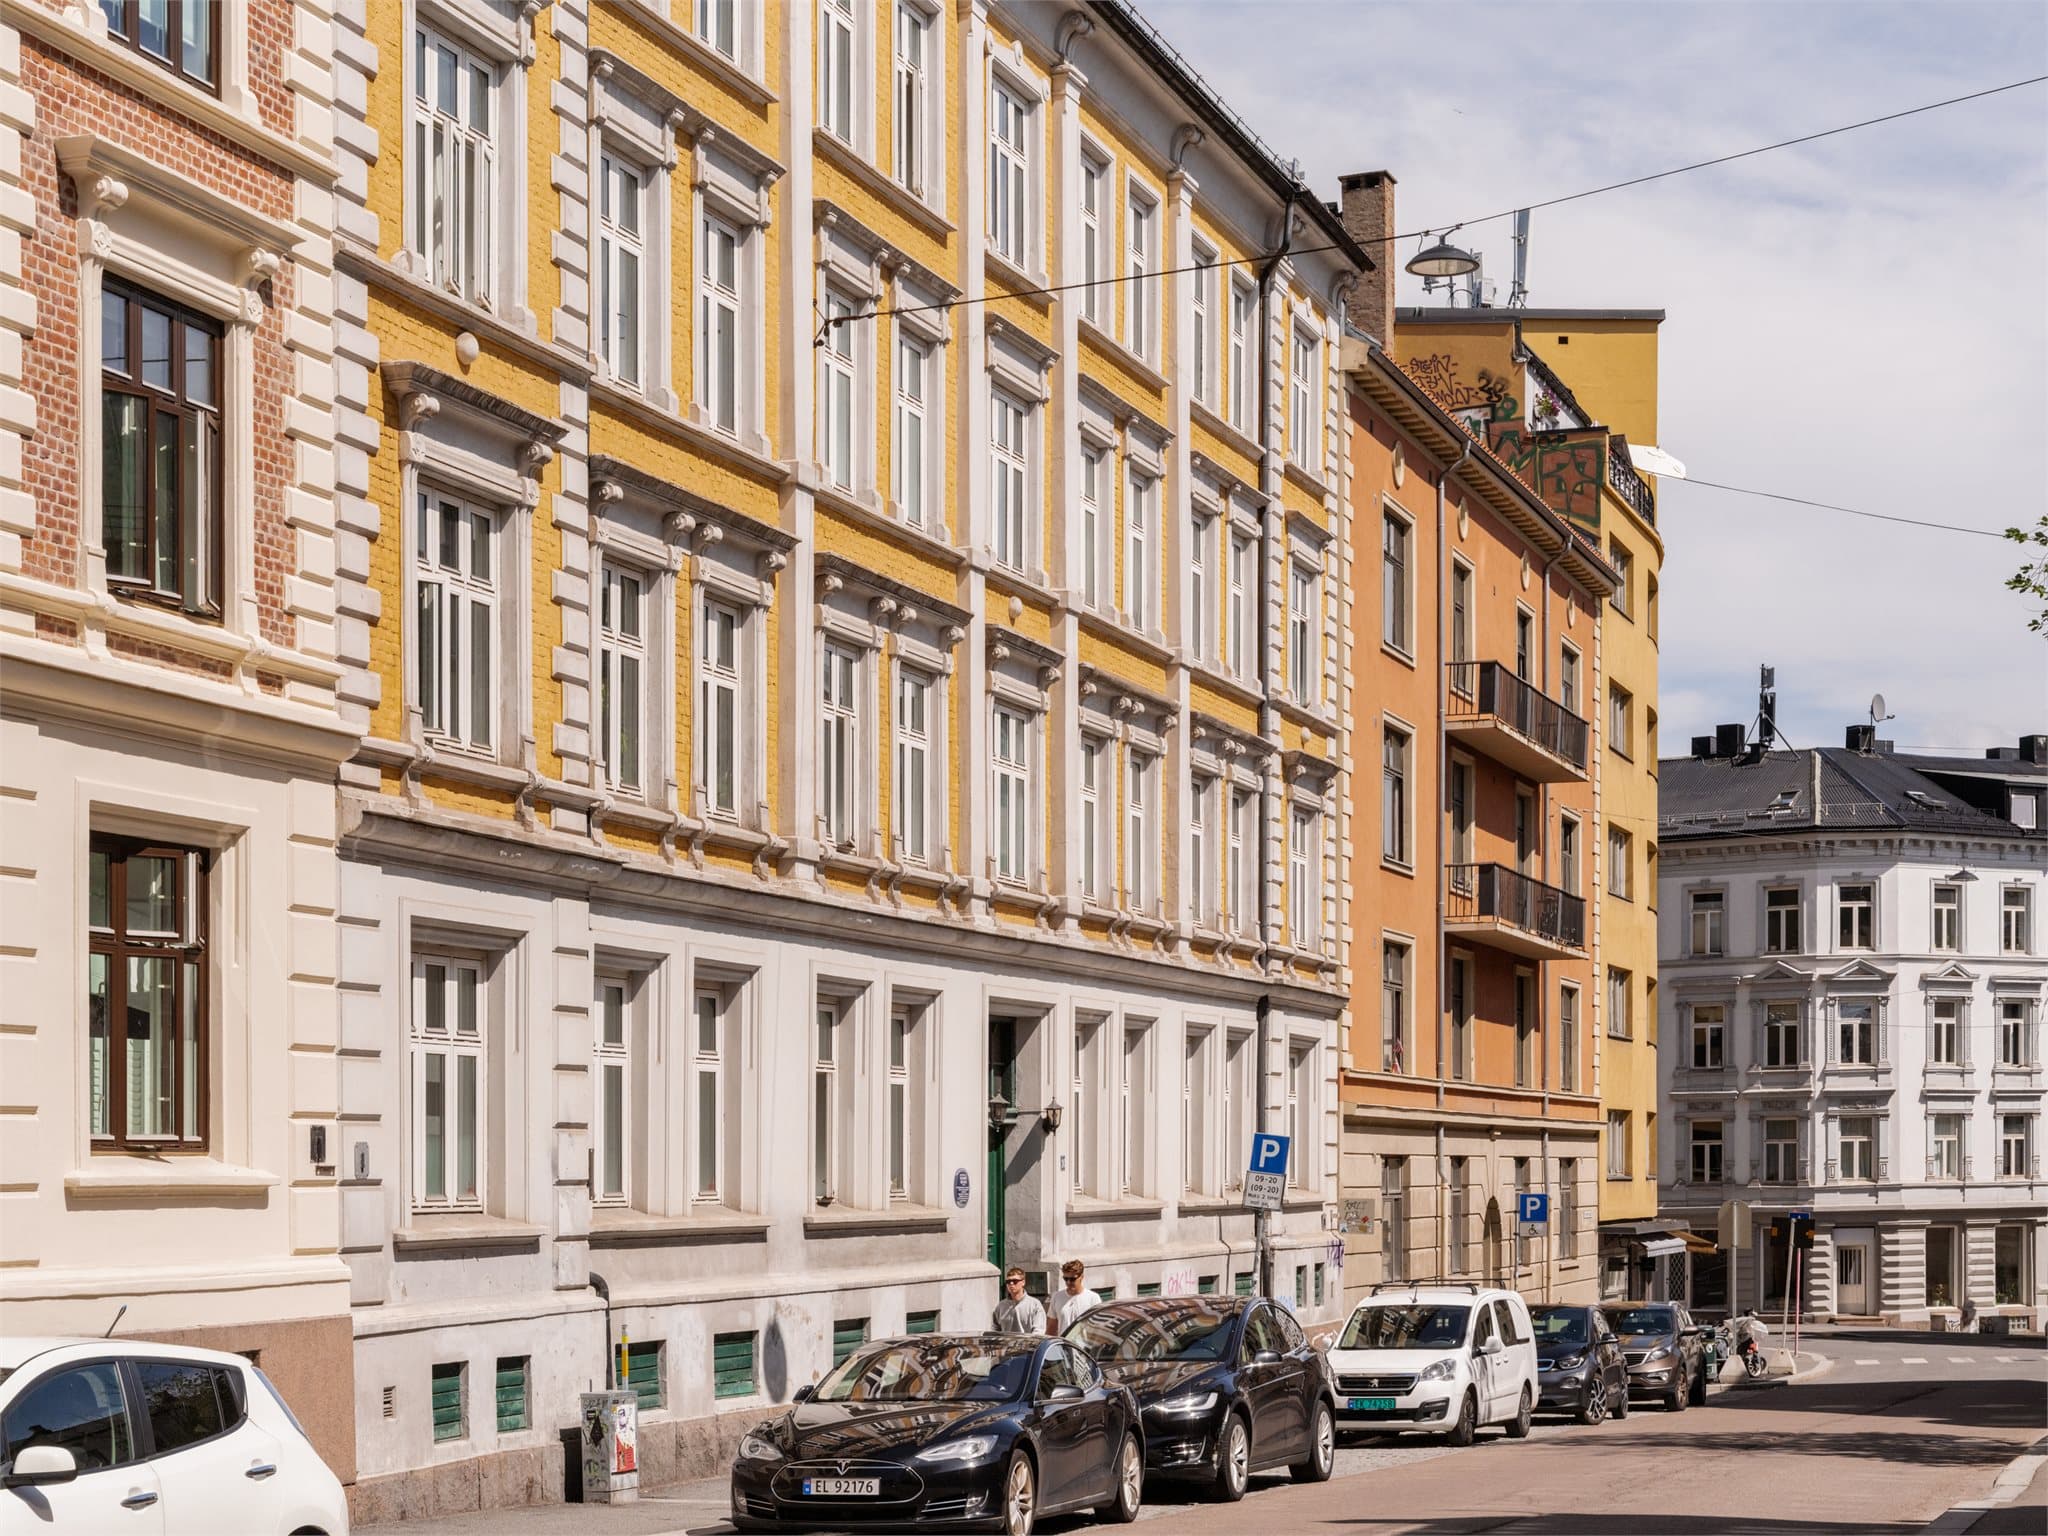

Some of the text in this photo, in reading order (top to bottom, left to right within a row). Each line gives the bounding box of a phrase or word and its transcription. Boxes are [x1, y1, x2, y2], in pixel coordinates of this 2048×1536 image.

[1259, 1139, 1280, 1168] P
[1255, 1175, 1277, 1184] 09-20
[1251, 1184, 1279, 1193] (09-20)
[1526, 1197, 1540, 1218] P
[816, 1480, 873, 1493] EL 92176
